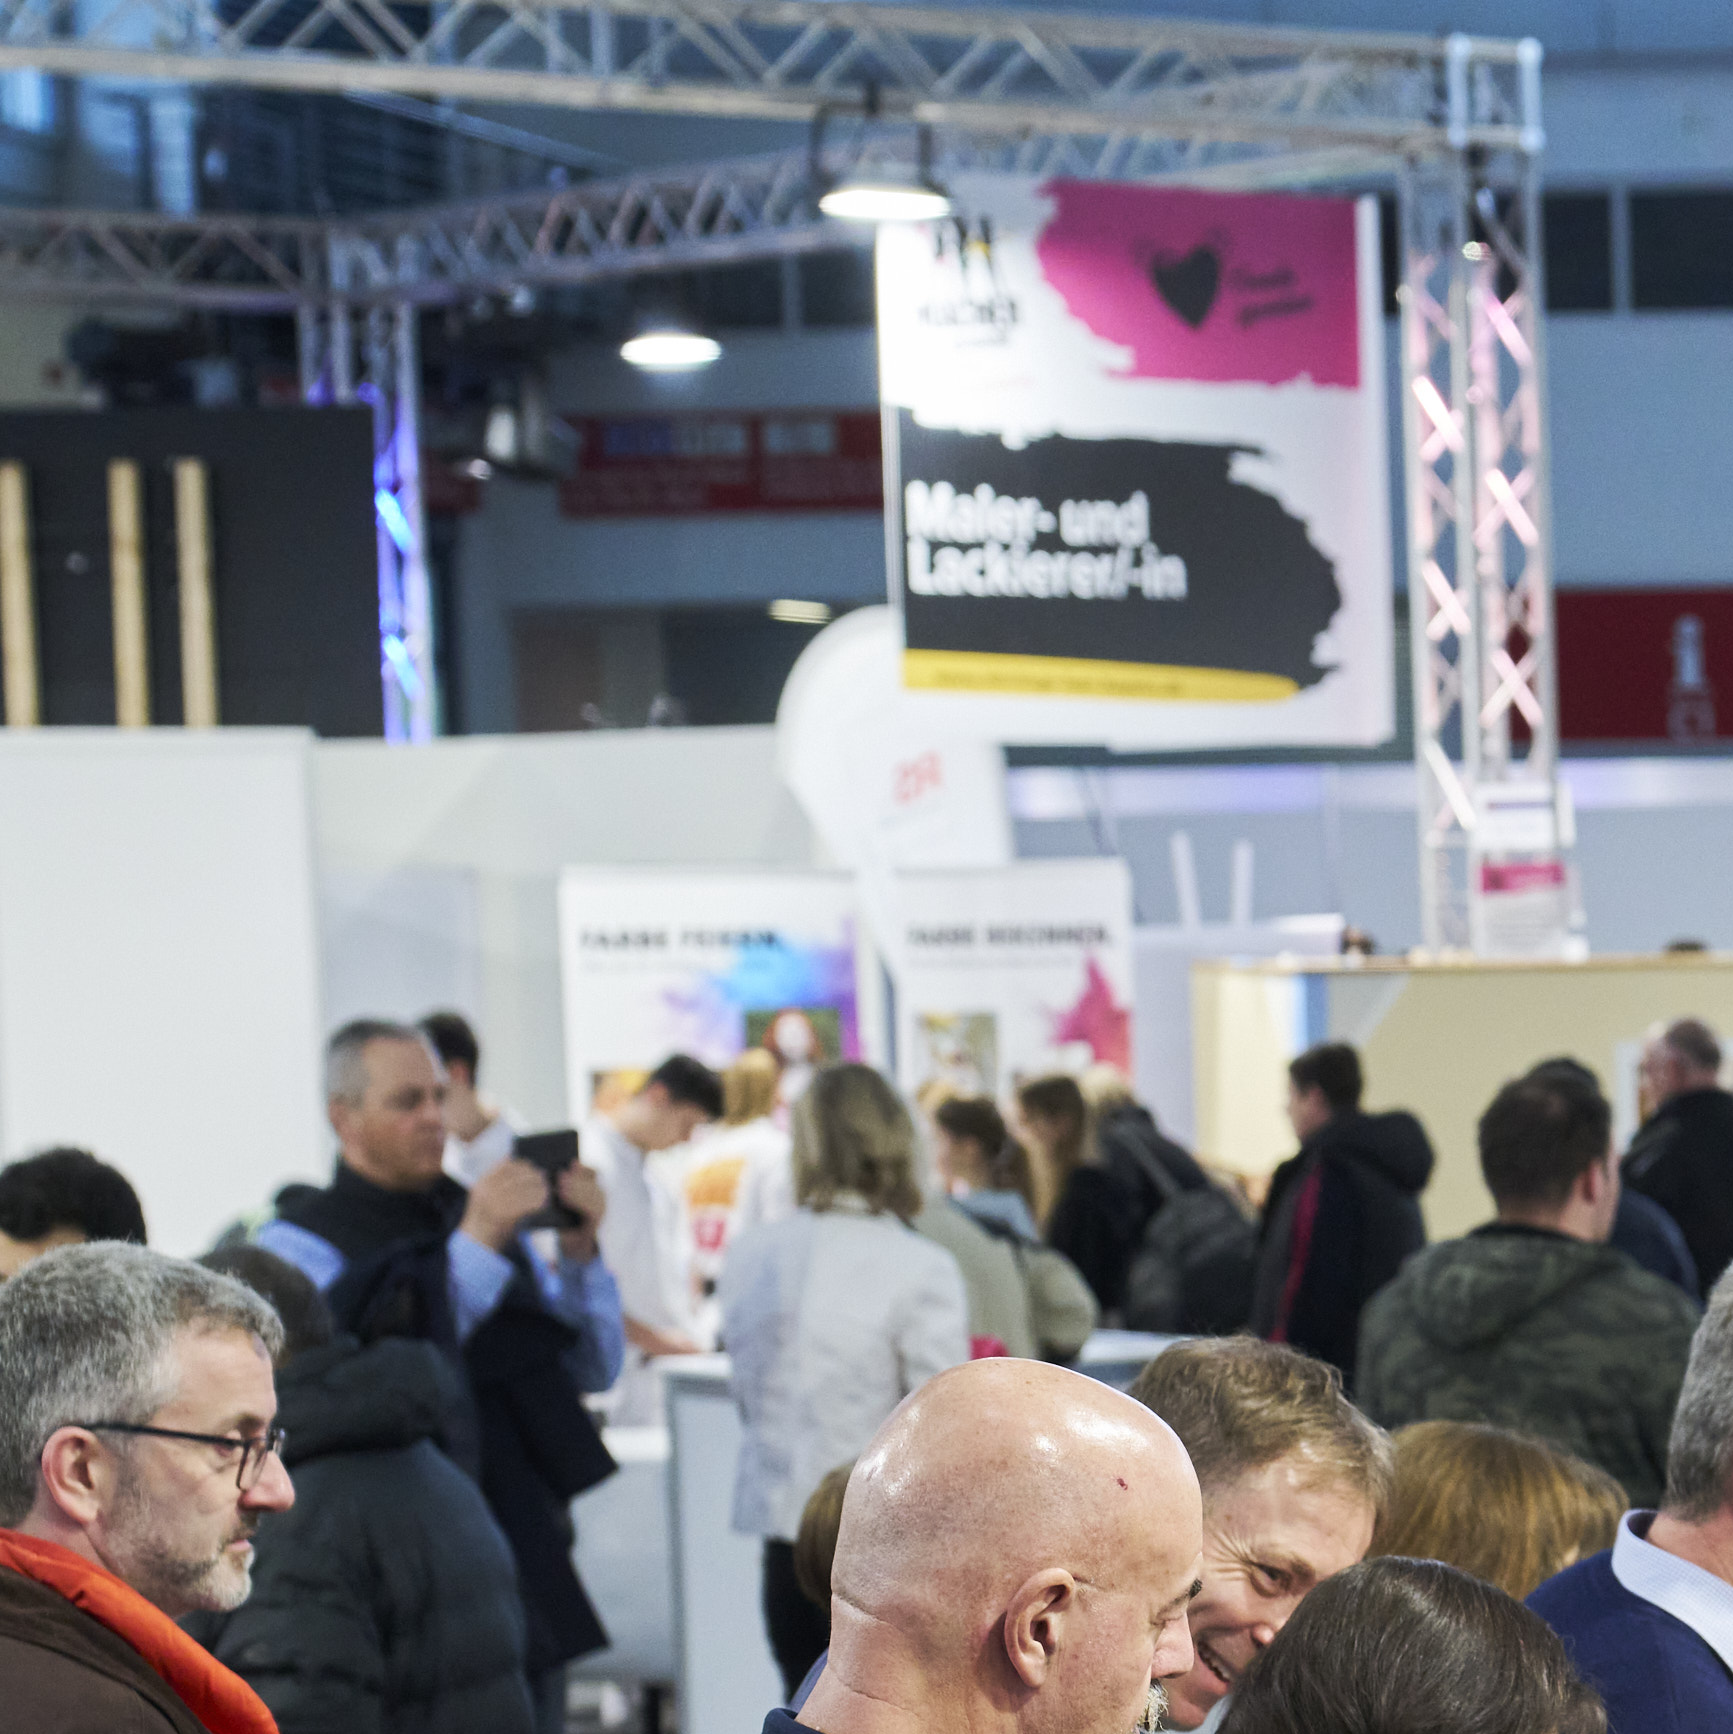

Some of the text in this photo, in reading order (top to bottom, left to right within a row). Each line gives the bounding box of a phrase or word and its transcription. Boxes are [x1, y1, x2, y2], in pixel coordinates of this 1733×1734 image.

[905, 480, 1150, 547] Maler- und
[907, 538, 1188, 600] Lackierer/-in
